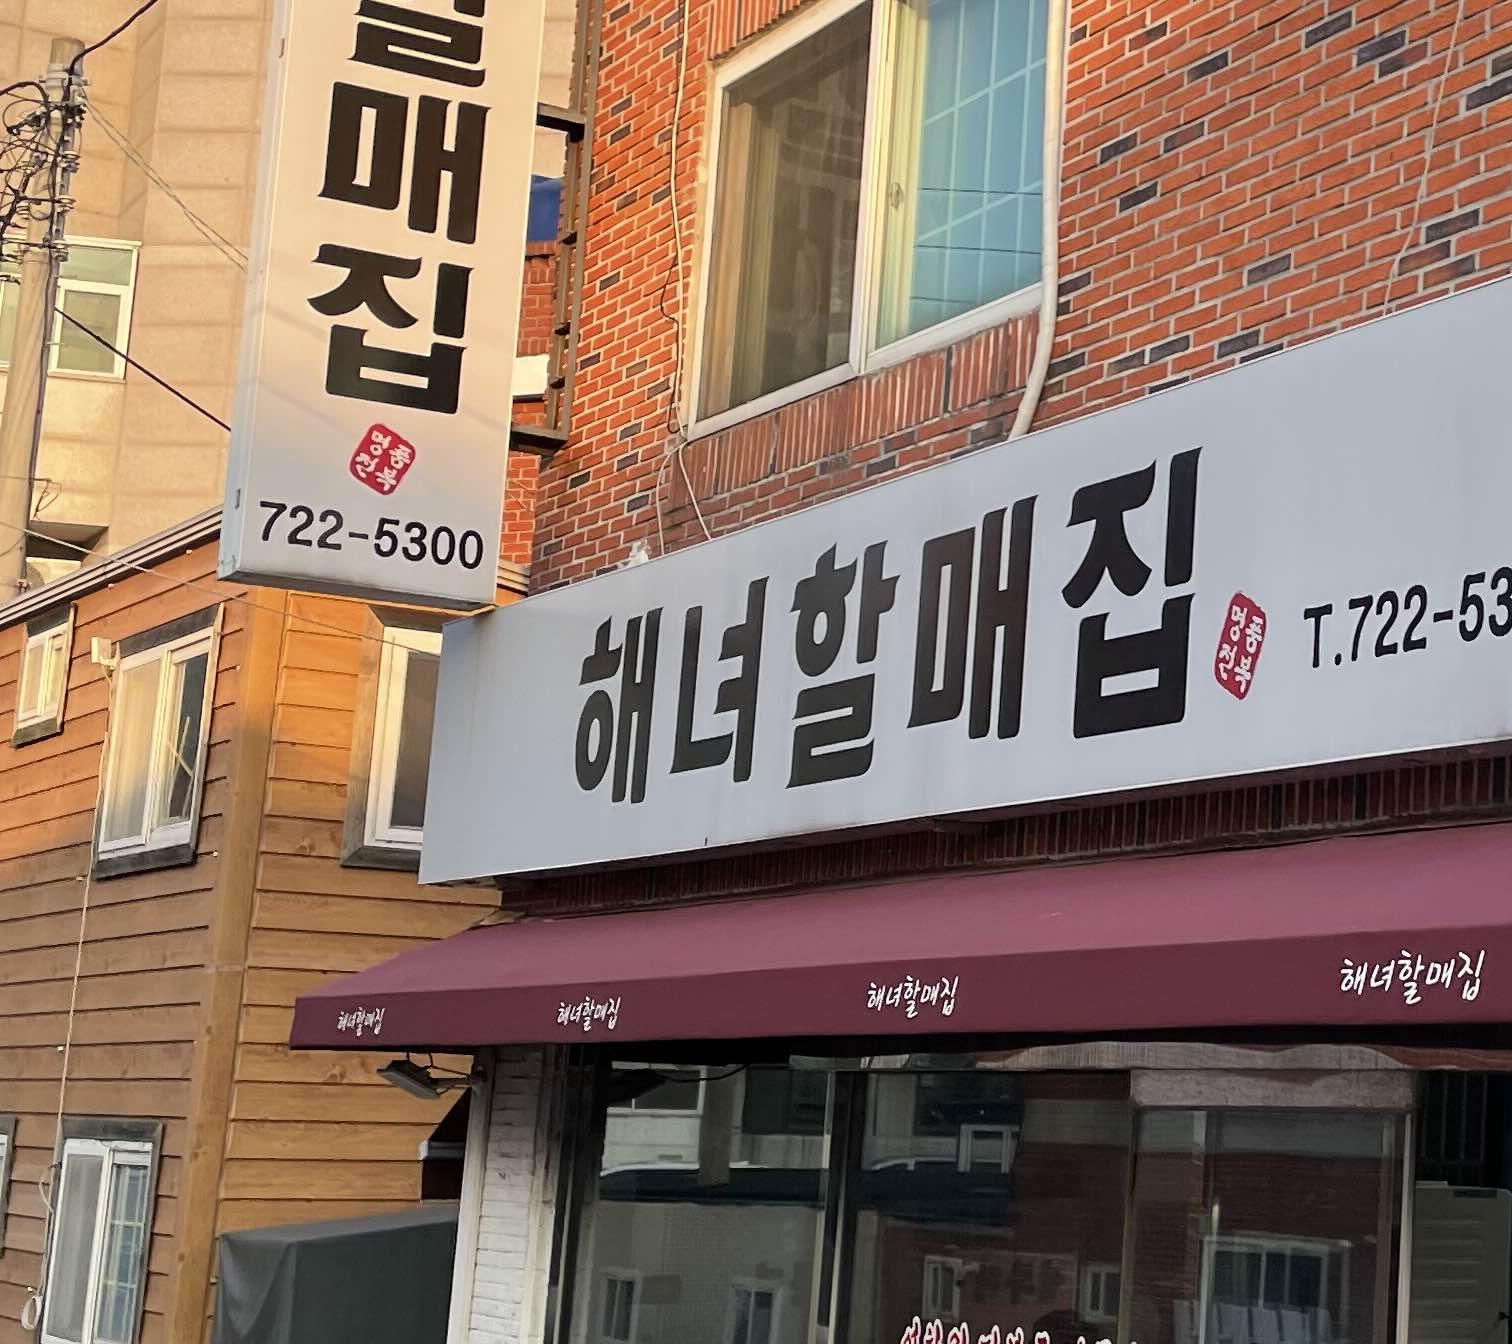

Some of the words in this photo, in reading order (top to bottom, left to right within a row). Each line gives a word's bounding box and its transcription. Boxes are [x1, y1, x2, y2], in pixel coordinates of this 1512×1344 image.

[259, 501, 483, 569] 722-5300
[575, 446, 1203, 805] 해녀할매집
[867, 975, 959, 1018] 해녀할매집
[1340, 949, 1486, 1004] 해녀할매집
[337, 1006, 386, 1037] 해녀할매집
[557, 996, 621, 1031] 해녀할매집
